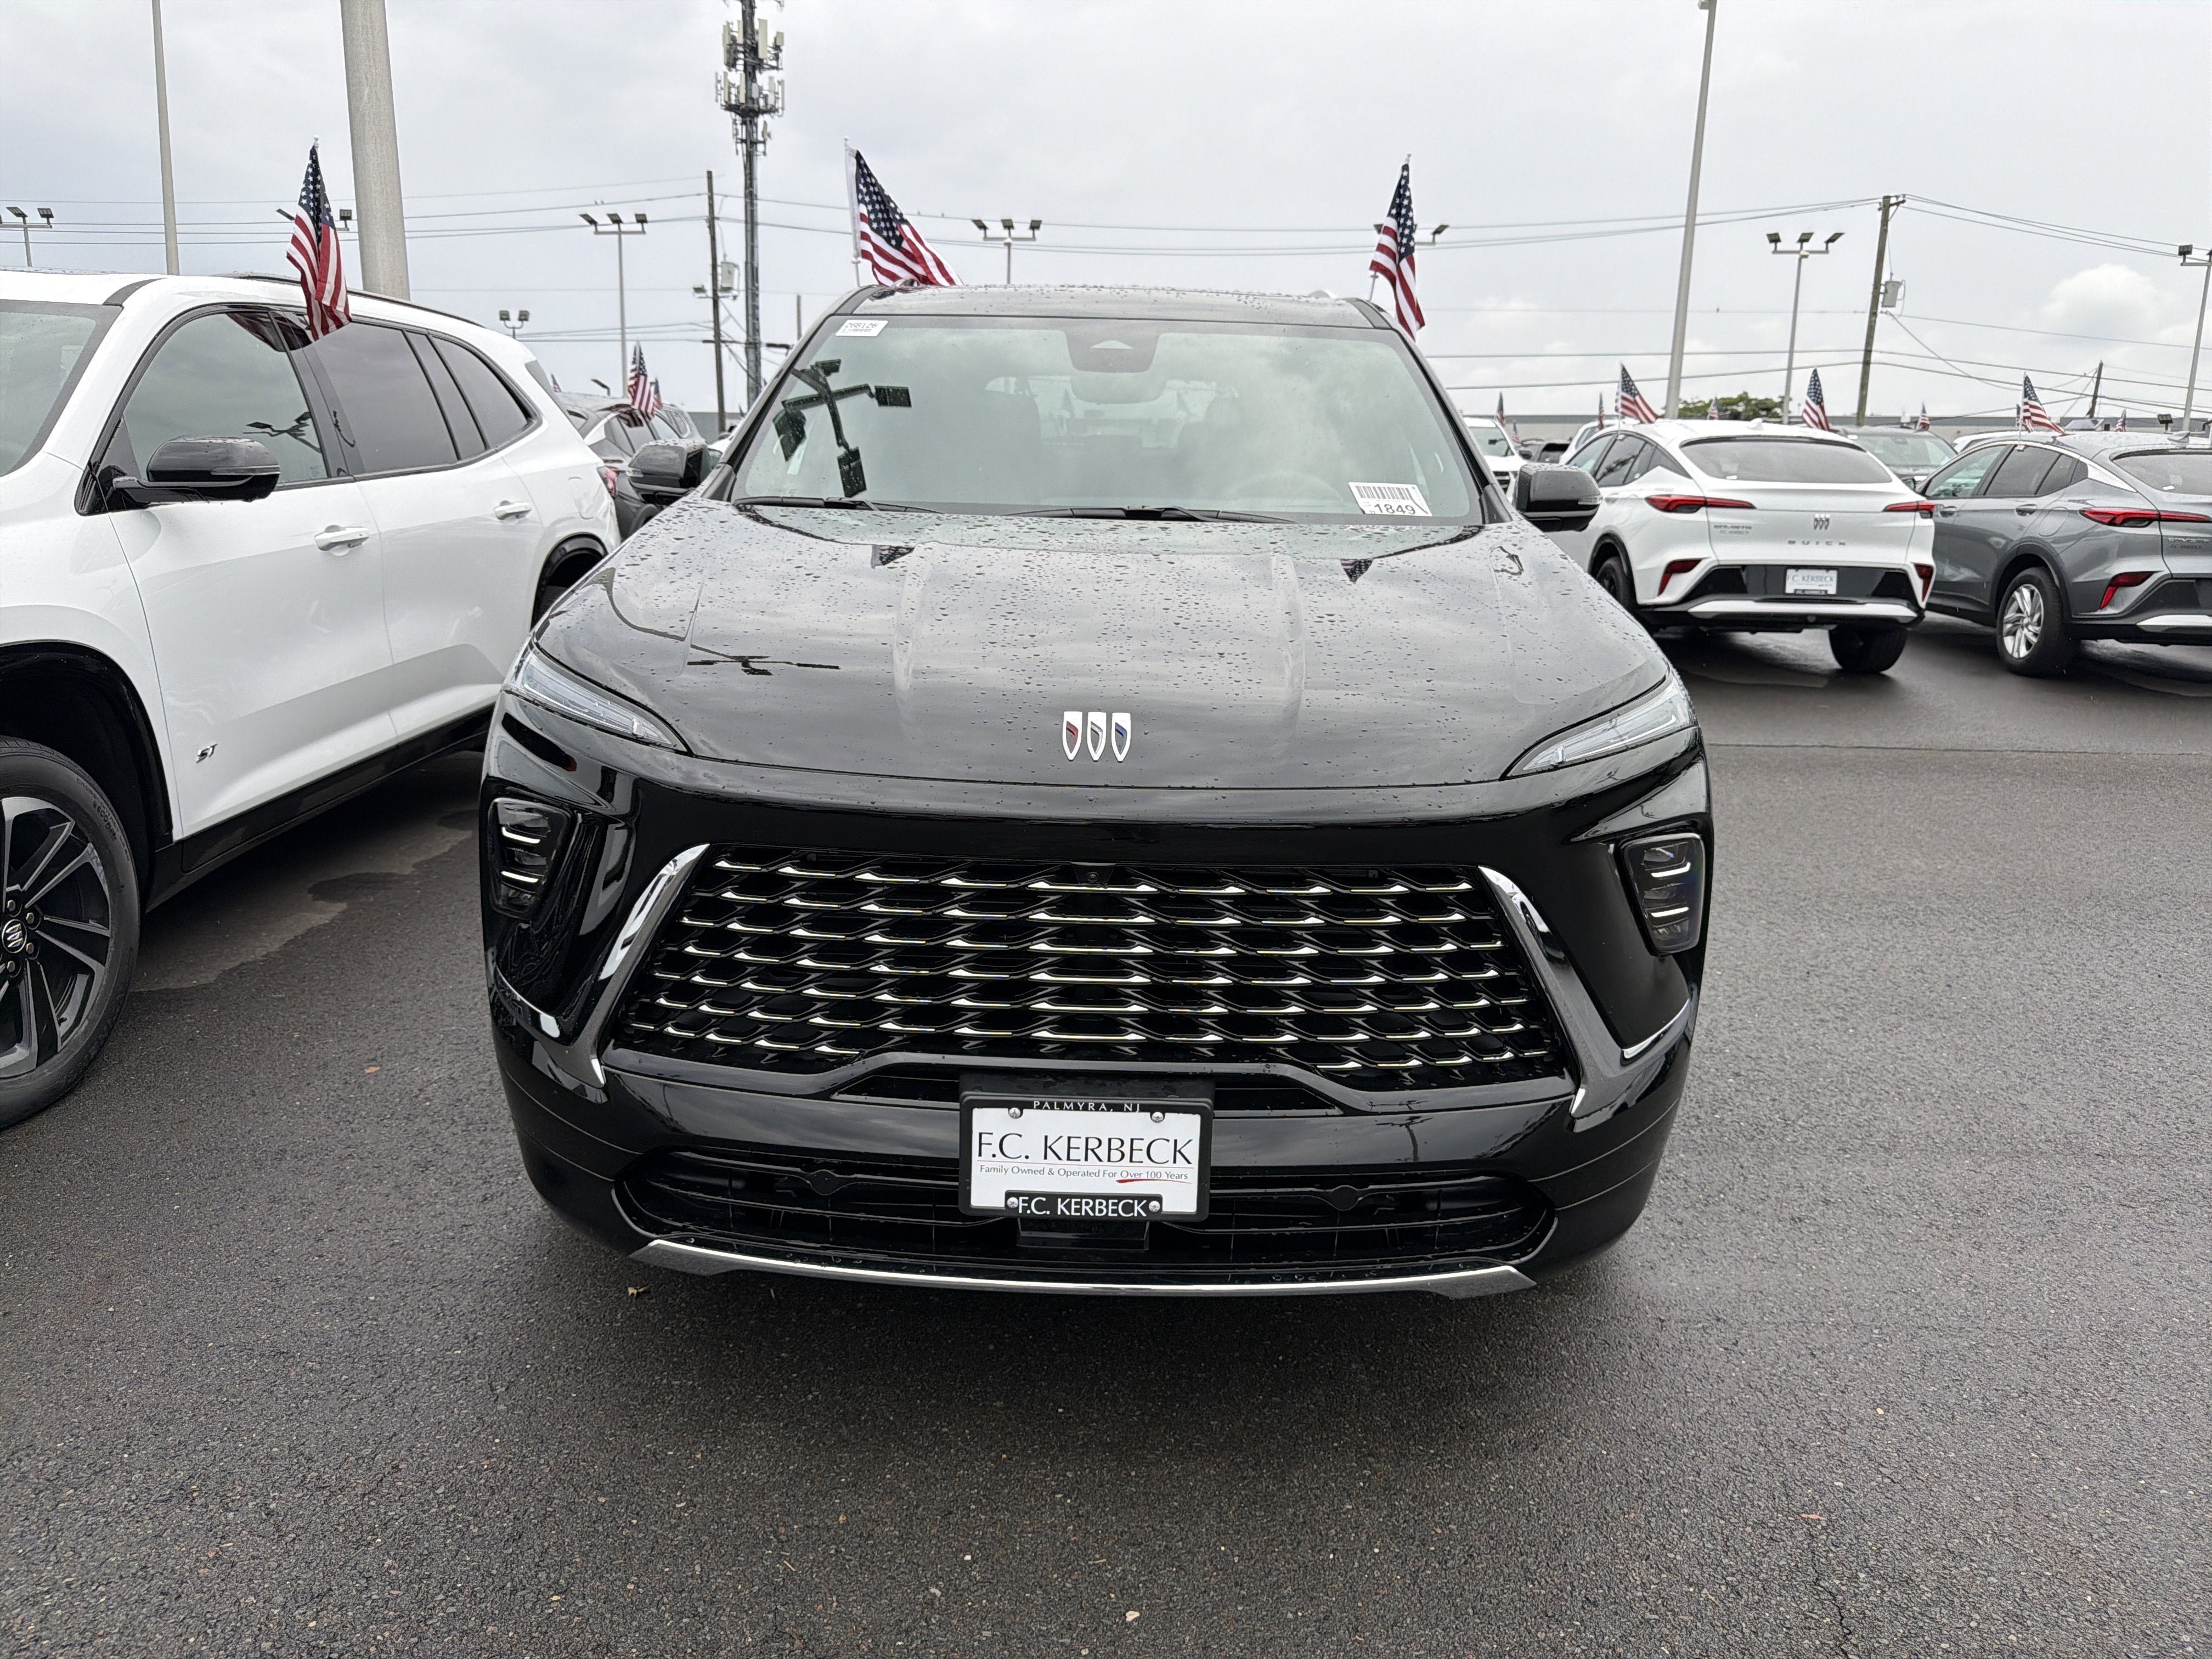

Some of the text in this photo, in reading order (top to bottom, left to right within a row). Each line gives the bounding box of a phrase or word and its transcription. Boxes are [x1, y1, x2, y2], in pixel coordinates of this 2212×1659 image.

[1374, 504, 1416, 515] 1849
[1034, 1101, 1141, 1113] PALMYRA, NJ
[977, 1132, 1193, 1165] F.C. KERBECK
[980, 1164, 1188, 1180] Family Owned & Operated For Over 100 Years
[1018, 1197, 1147, 1217] F.C. KERBECK
